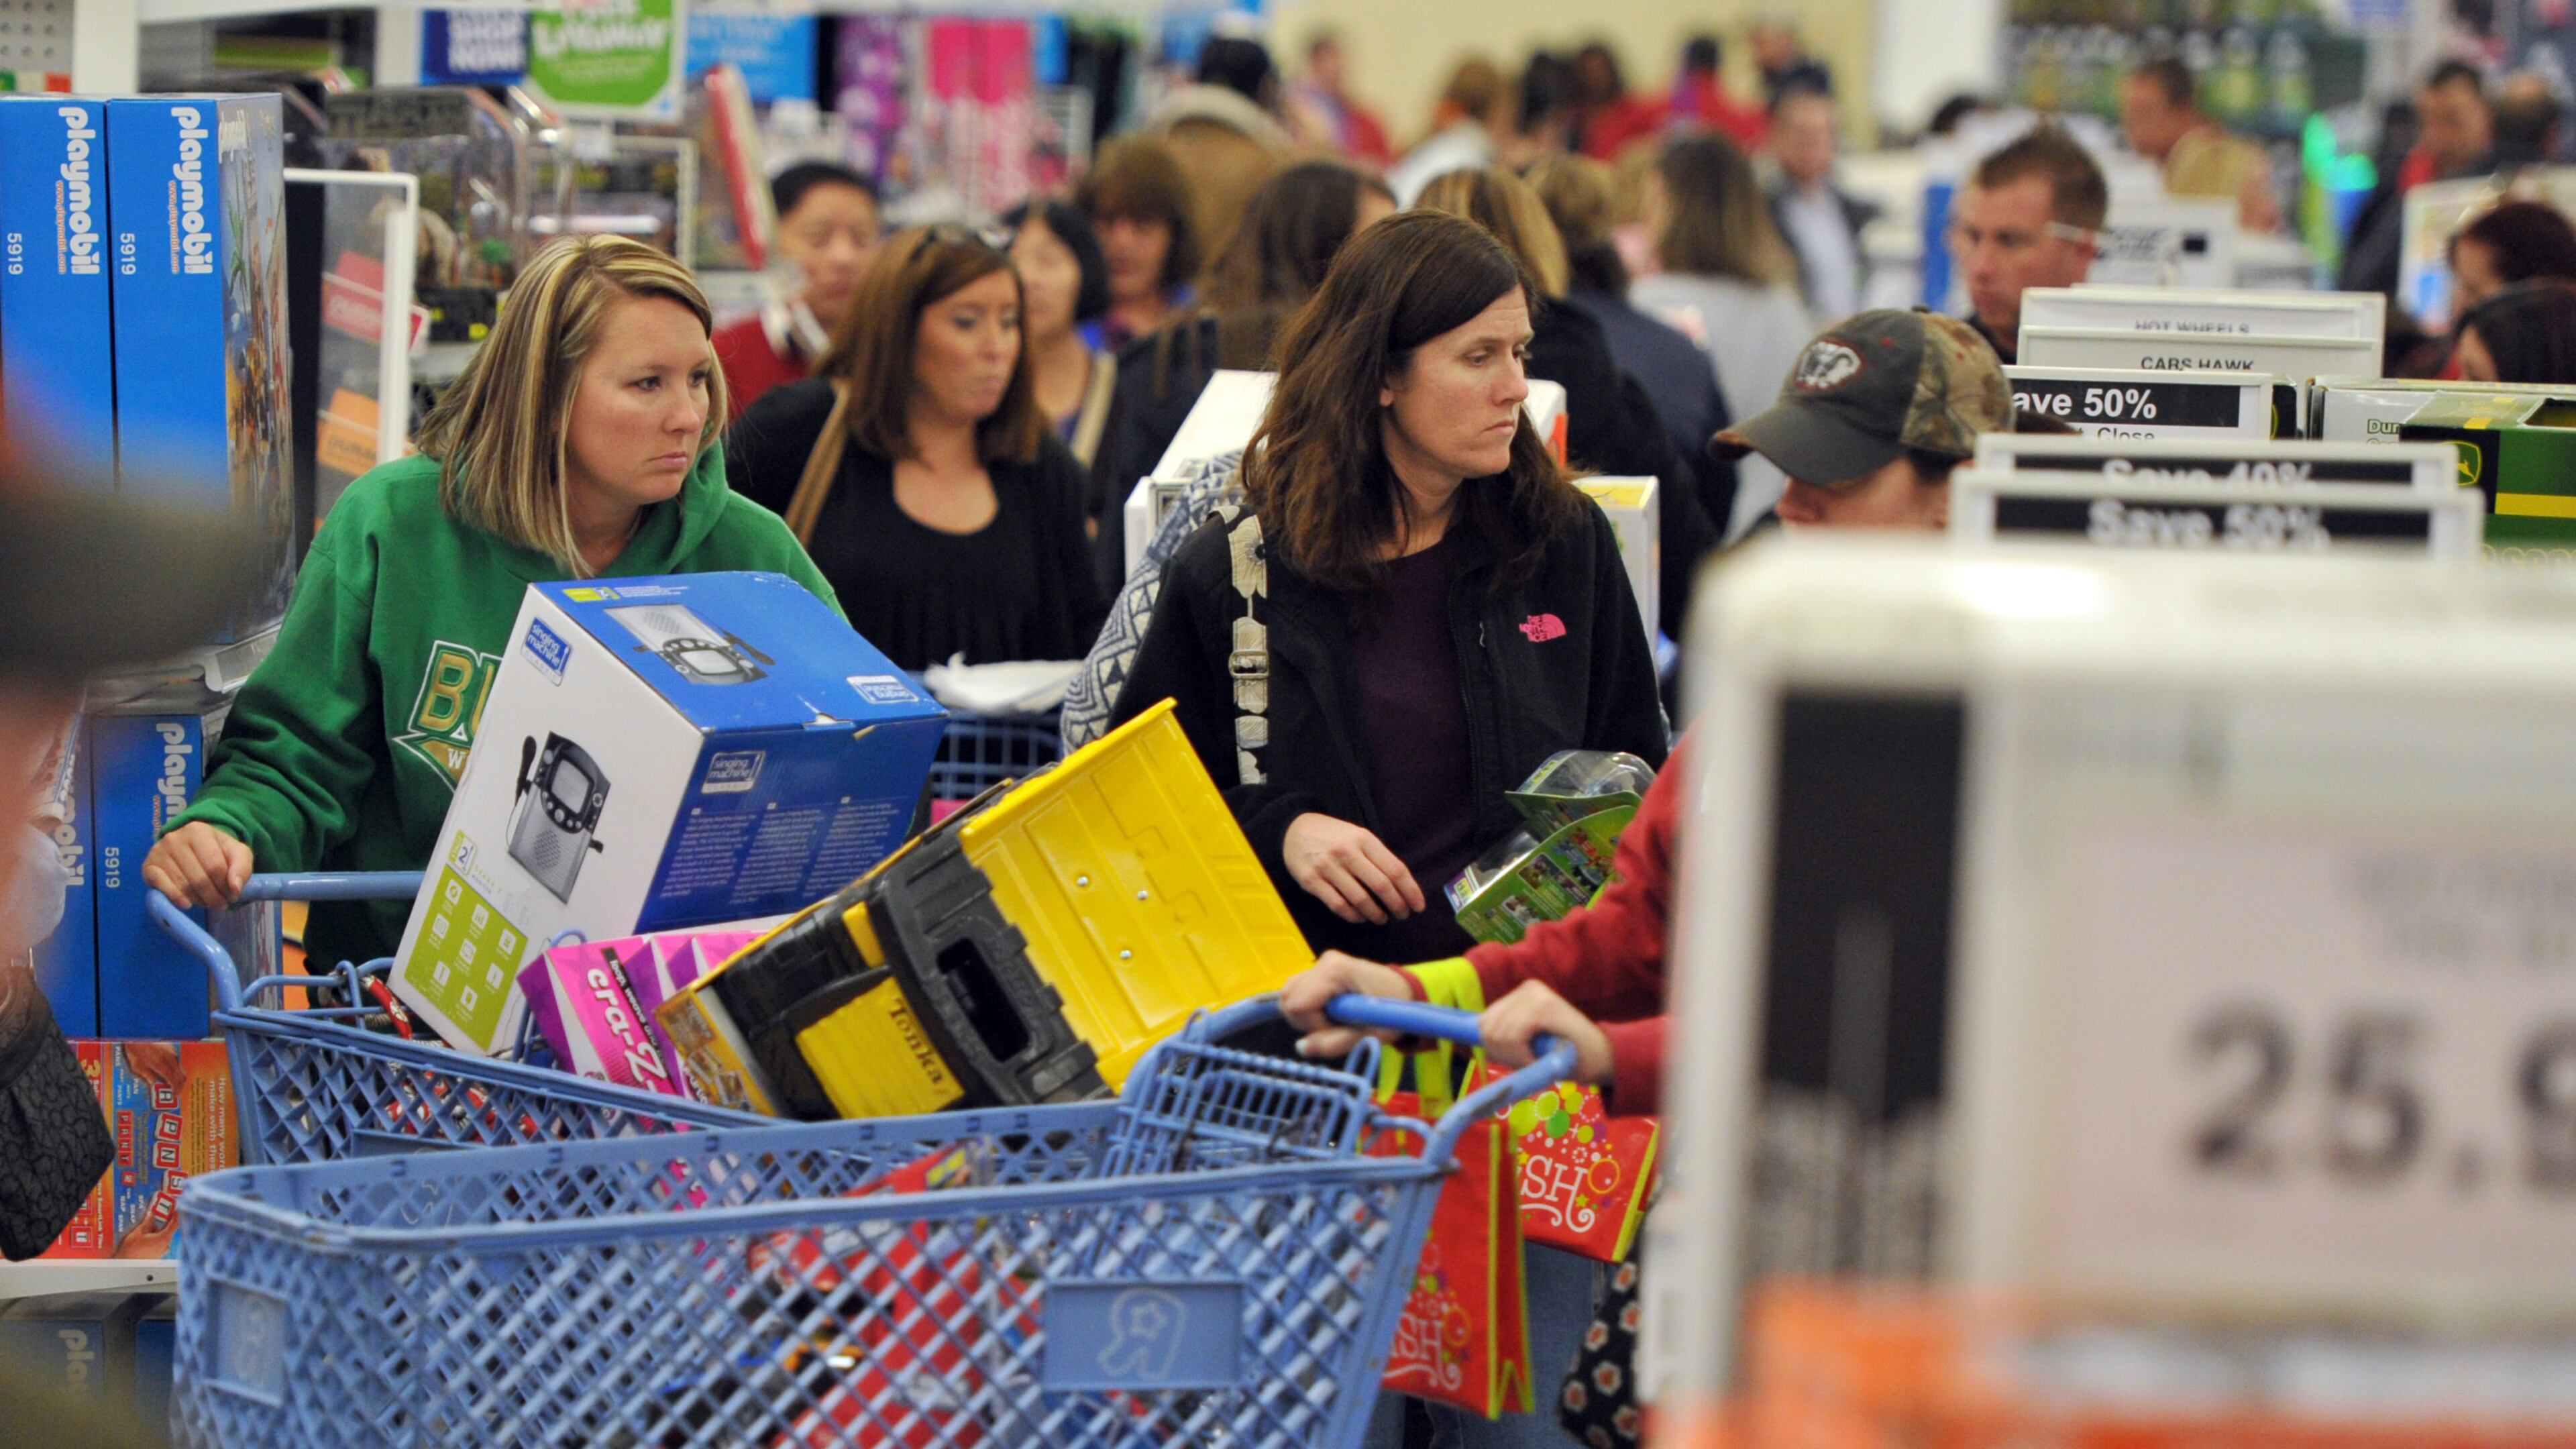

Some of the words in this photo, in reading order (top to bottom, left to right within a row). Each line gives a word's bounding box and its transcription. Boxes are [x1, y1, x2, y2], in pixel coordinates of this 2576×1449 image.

[58, 107, 100, 274] playmobil
[171, 107, 213, 274] playmobil
[56, 180, 66, 274] www.playmobil.com
[168, 180, 179, 274] www.playmobil.com
[7, 233, 23, 275] 5919
[120, 233, 136, 275] 5919
[2141, 356, 2193, 371] CARS
[2012, 393, 2072, 415] ave
[2083, 388, 2157, 419] 50%
[2367, 419, 2401, 435] Dur
[527, 634, 561, 667] machine
[532, 624, 560, 655] singing
[156, 722, 193, 821] playm
[105, 847, 120, 888] 5919
[610, 959, 627, 987] loop,
[625, 988, 647, 1023] weave
[889, 997, 943, 1084] Tonka
[219, 1077, 227, 1104] How
[166, 1121, 178, 1133] P
[217, 1107, 226, 1138] many
[162, 1148, 175, 1161] N
[1520, 1155, 1591, 1220] SH
